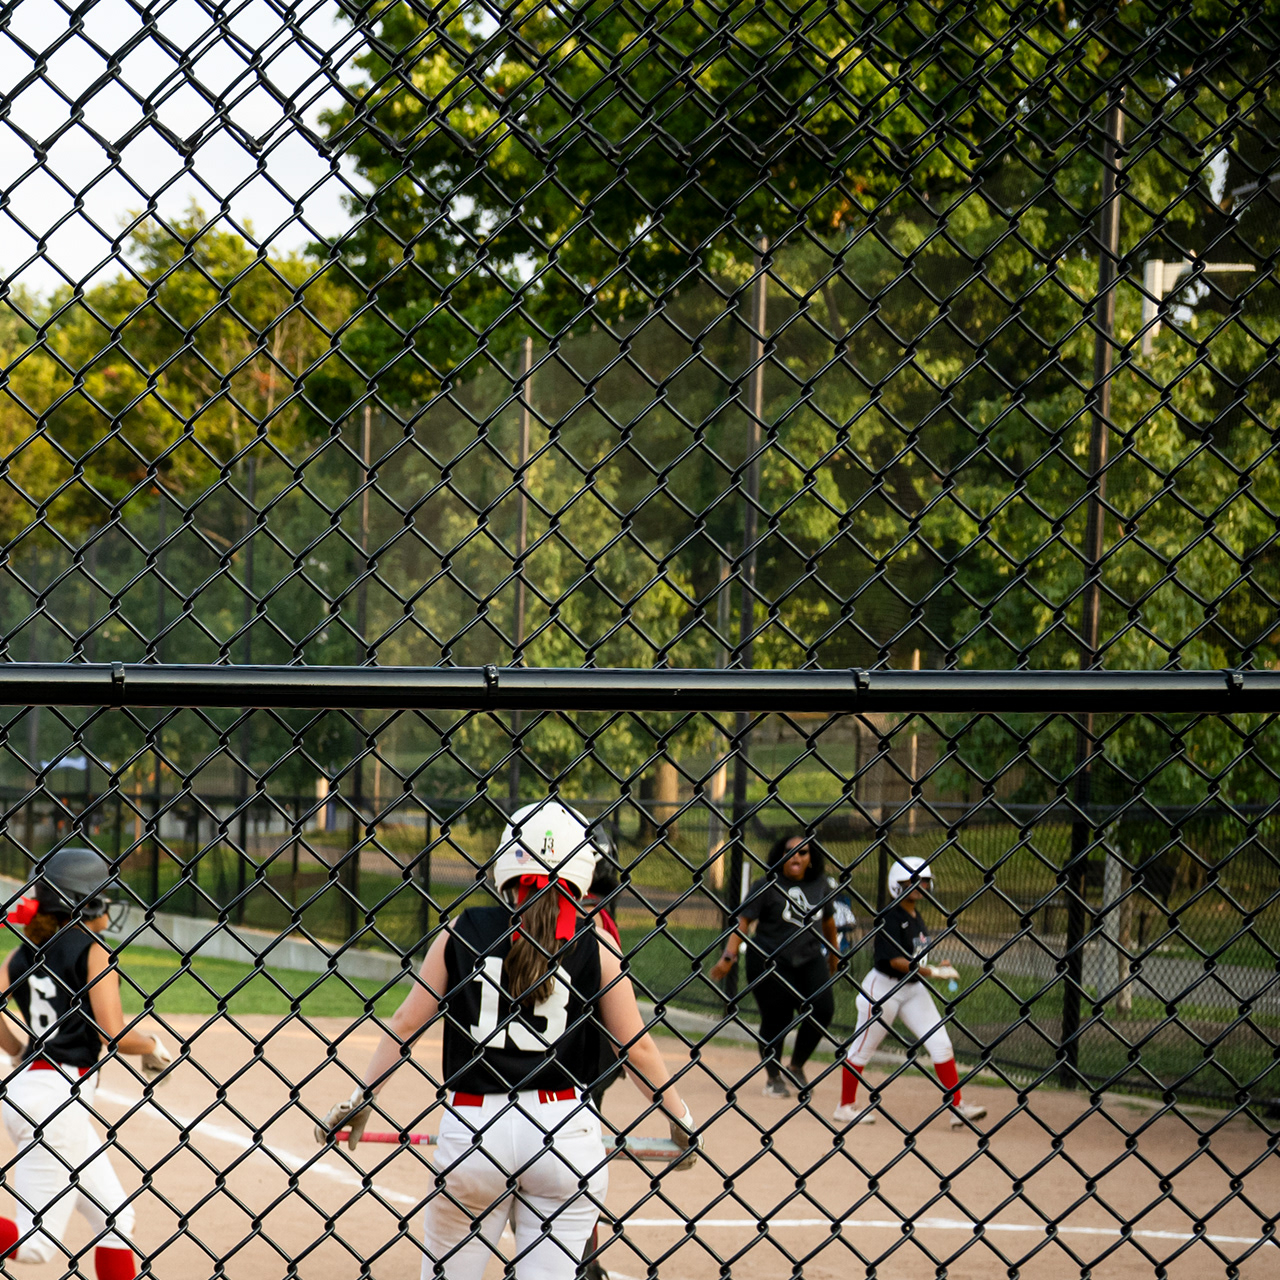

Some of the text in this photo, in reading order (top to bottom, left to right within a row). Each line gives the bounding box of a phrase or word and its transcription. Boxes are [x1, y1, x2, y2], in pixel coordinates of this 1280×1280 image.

[543, 837, 555, 850] 13
[28, 974, 60, 1042] 6
[470, 956, 572, 1052] 13
